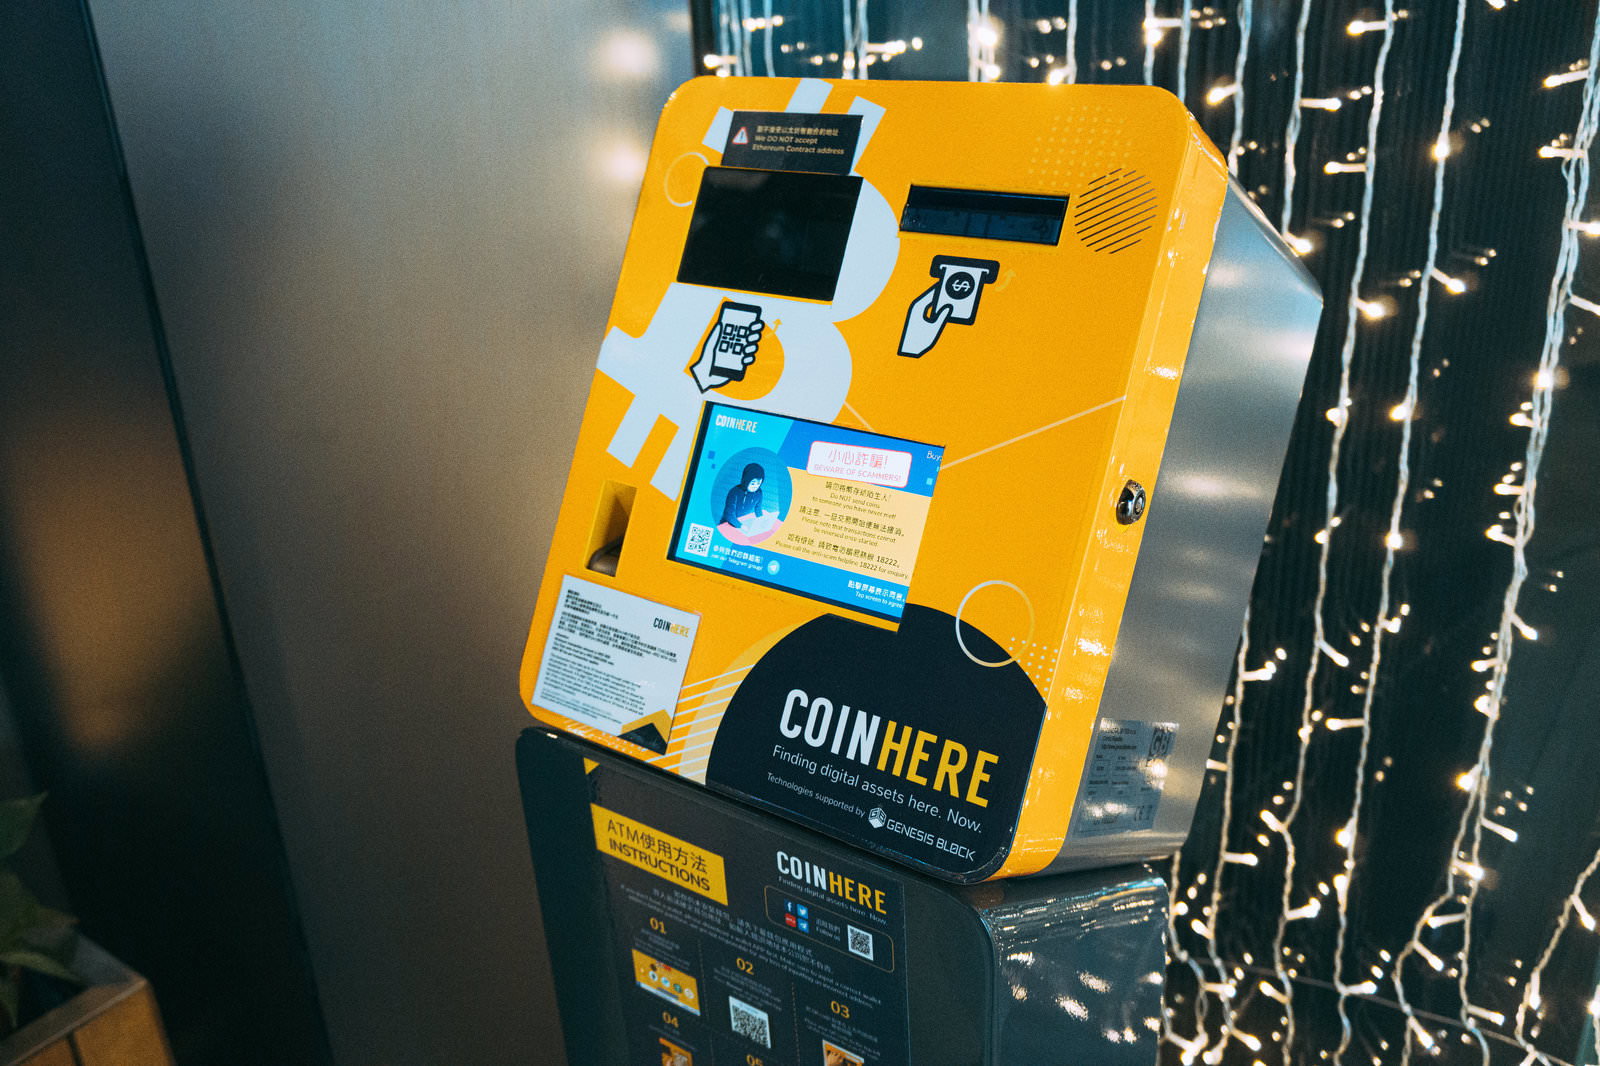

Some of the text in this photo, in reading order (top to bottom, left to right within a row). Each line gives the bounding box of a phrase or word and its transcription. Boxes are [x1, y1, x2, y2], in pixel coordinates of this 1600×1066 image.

[715, 414, 758, 433] COINHERE
[814, 463, 844, 474] BEWARE
[857, 469, 902, 482] SCAMMERS!
[840, 494, 852, 502] NOT
[853, 497, 866, 506] send
[843, 502, 853, 510] you
[854, 504, 868, 513] have
[868, 508, 884, 517] never
[820, 520, 832, 529] note
[832, 523, 843, 531] that
[860, 561, 877, 571] 18222
[865, 593, 882, 603] screen
[653, 617, 690, 638] COINHERE
[779, 688, 1000, 808] COINHERE
[767, 772, 866, 819] Technologies supported by
[772, 744, 983, 834] Finding digital assets here. Now.
[886, 818, 935, 846] GENESIS
[607, 819, 708, 874] ATM使用方法
[609, 837, 711, 892] INSTRUCTIONS
[776, 850, 888, 915] COINHERE
[779, 876, 804, 892] Finding
[649, 917, 667, 934] 01
[736, 957, 755, 976] 02
[830, 1000, 850, 1019] 03
[662, 1011, 679, 1029] 04
